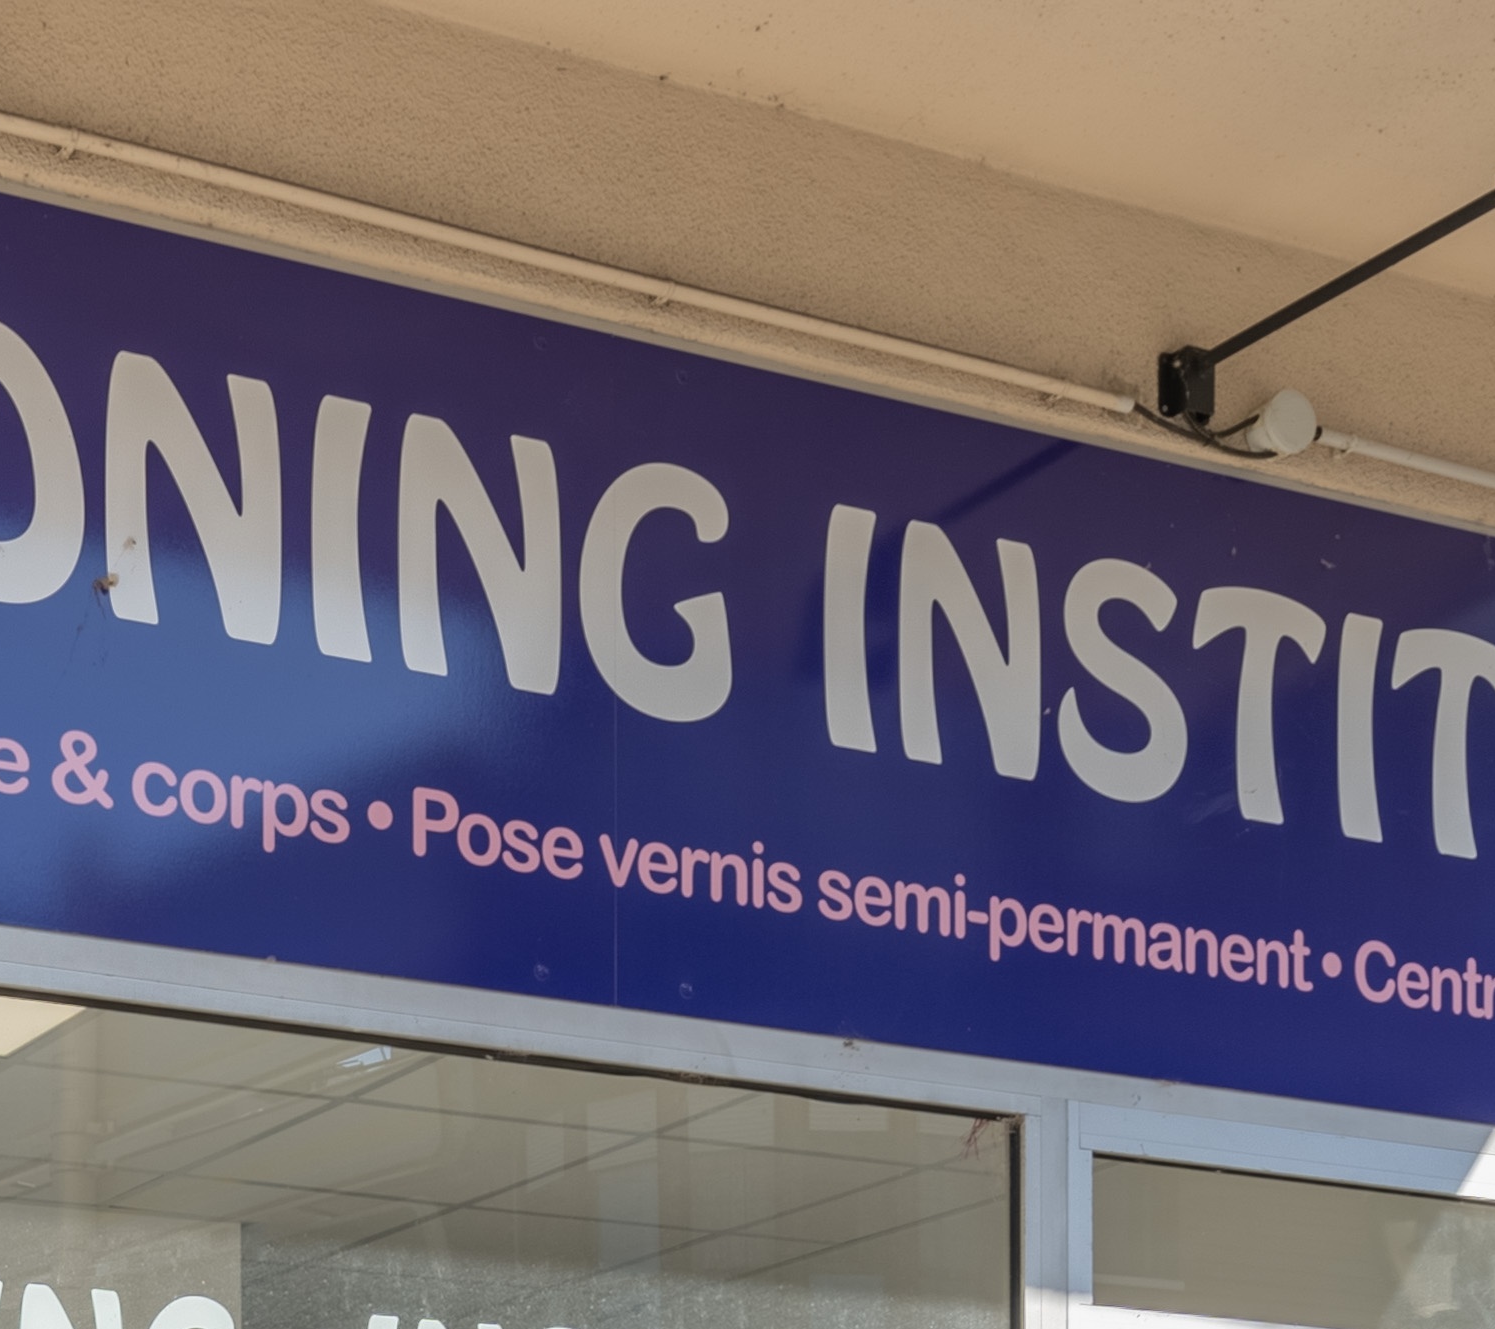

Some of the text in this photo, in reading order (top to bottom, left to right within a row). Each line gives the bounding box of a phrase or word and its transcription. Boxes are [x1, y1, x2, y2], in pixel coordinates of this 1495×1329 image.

[51, 730, 115, 809] &
[132, 762, 350, 852] corps
[412, 787, 584, 880] Pose
[600, 834, 803, 914] vernis
[817, 866, 1313, 991] semi-permanent
